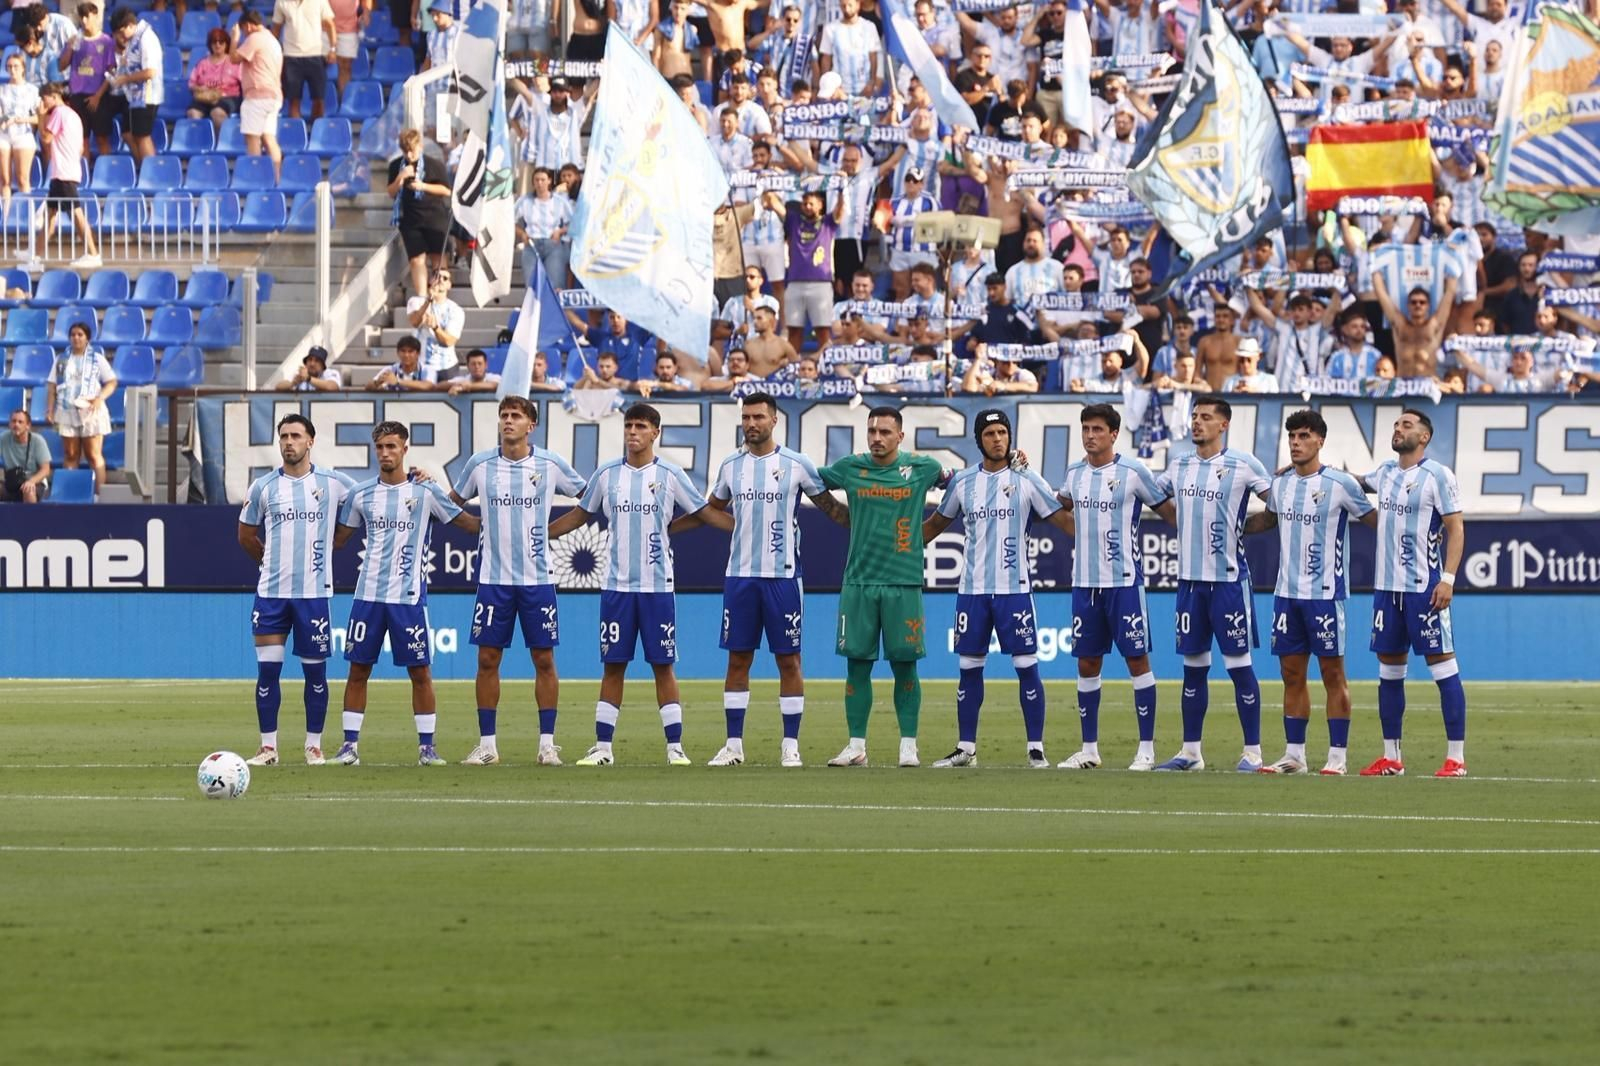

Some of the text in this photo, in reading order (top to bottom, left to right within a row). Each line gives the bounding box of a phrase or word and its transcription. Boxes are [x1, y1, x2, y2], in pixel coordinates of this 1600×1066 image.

[784, 102, 848, 122] FONDO
[784, 125, 839, 140] FONDO
[966, 136, 1025, 161] FONDO
[867, 302, 917, 316] PADRES
[825, 346, 883, 363] FONDO
[867, 363, 928, 384] FONDO
[735, 381, 796, 398] FONDO
[530, 525, 544, 559] UAX
[770, 520, 784, 553] UAX
[896, 517, 912, 553] UAX
[1106, 529, 1120, 562] UAX
[1143, 534, 1178, 554] Die
[1210, 521, 1224, 555] UAX
[313, 540, 324, 572] UAX
[649, 532, 661, 566] UAX
[1003, 536, 1017, 570] UAX
[1400, 534, 1414, 567] UAX
[399, 545, 414, 577] UAX
[1143, 555, 1178, 576] Día
[1307, 543, 1322, 581] UAX
[474, 602, 494, 626] 21
[311, 634, 329, 643] MGS
[349, 618, 367, 642] 10
[600, 621, 620, 643] 29
[1015, 627, 1034, 636] MGS
[1125, 629, 1144, 638] MGS
[1227, 628, 1247, 637] MGS
[1316, 630, 1336, 639] MGS
[1420, 628, 1440, 637] MGS
[407, 641, 426, 650] MGS
